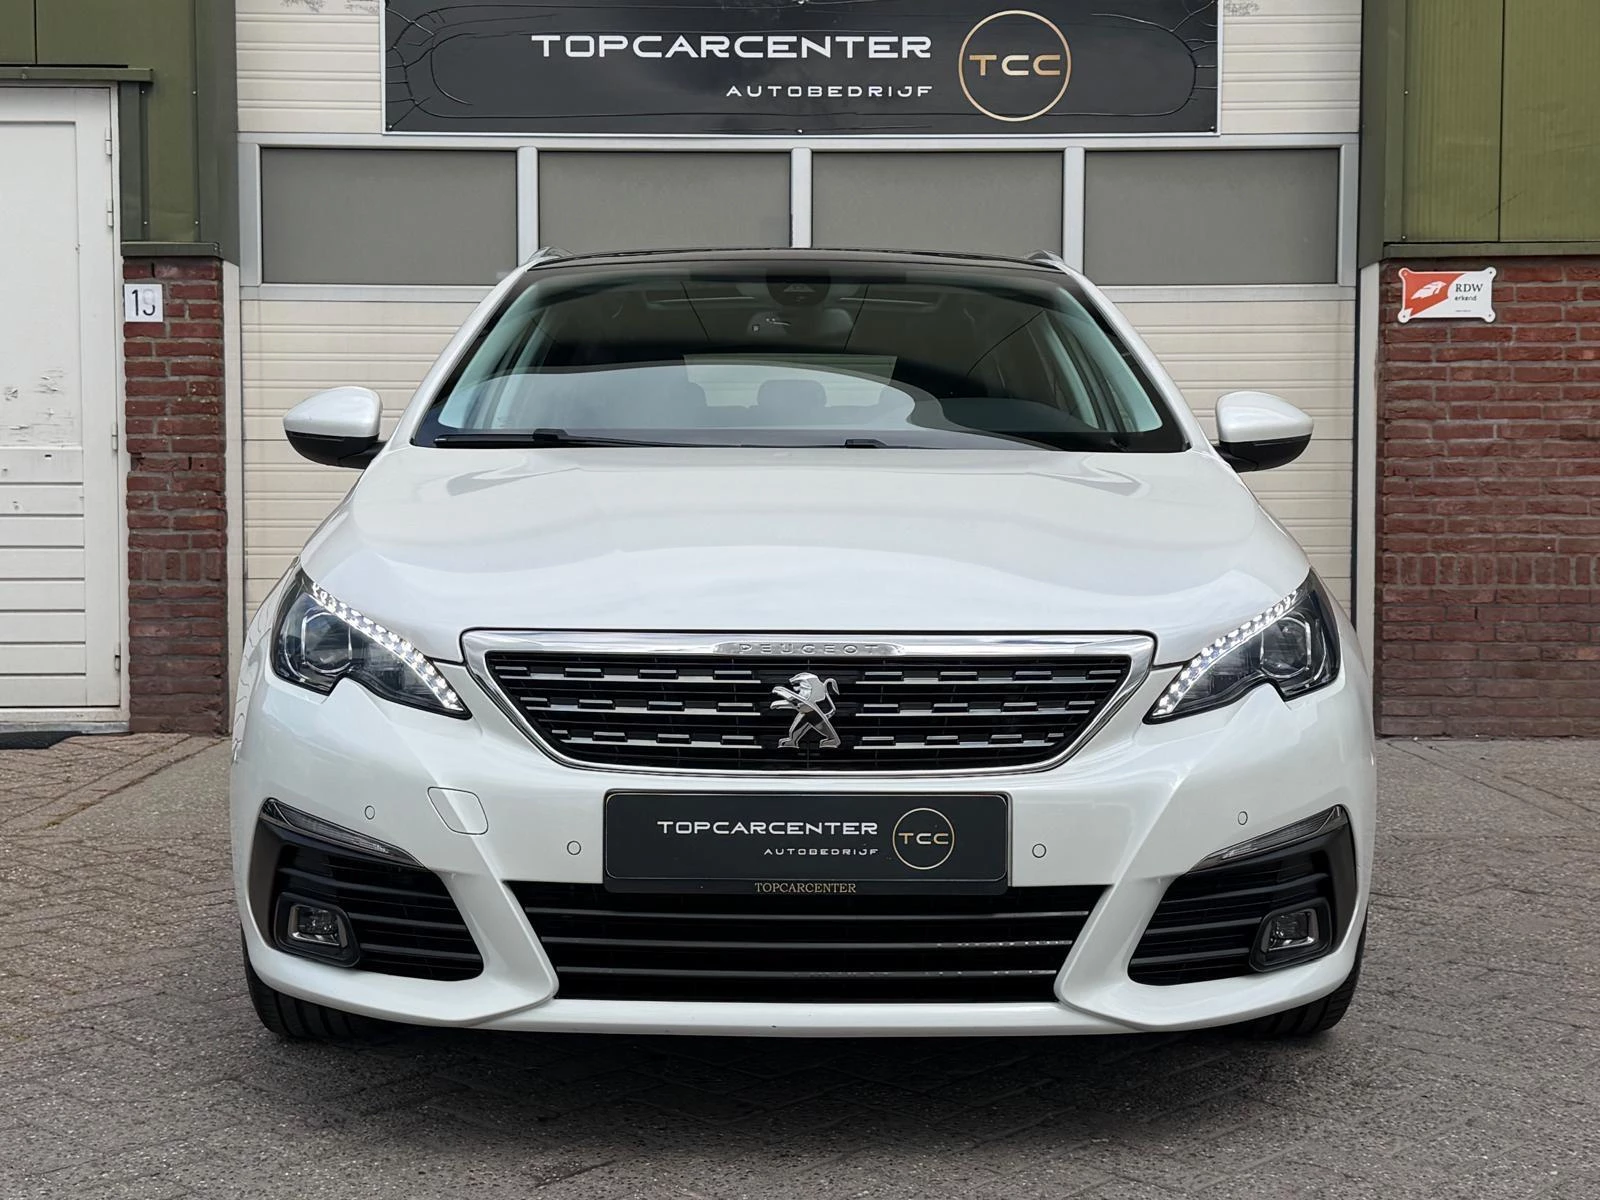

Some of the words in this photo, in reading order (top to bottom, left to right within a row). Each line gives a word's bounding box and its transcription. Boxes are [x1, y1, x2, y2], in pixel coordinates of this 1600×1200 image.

[531, 34, 932, 59] TOPCARCENTER
[969, 54, 1061, 76] TCC
[726, 85, 933, 98] AUTOBEDRIJF
[1455, 283, 1483, 293] RDW
[738, 643, 879, 655] PEUGEOT
[657, 821, 878, 836] TOPCARCENTER
[898, 832, 949, 845] TCC
[763, 848, 879, 856] AUTOBEDRIJF
[754, 882, 857, 894] TOPCARCENTER
